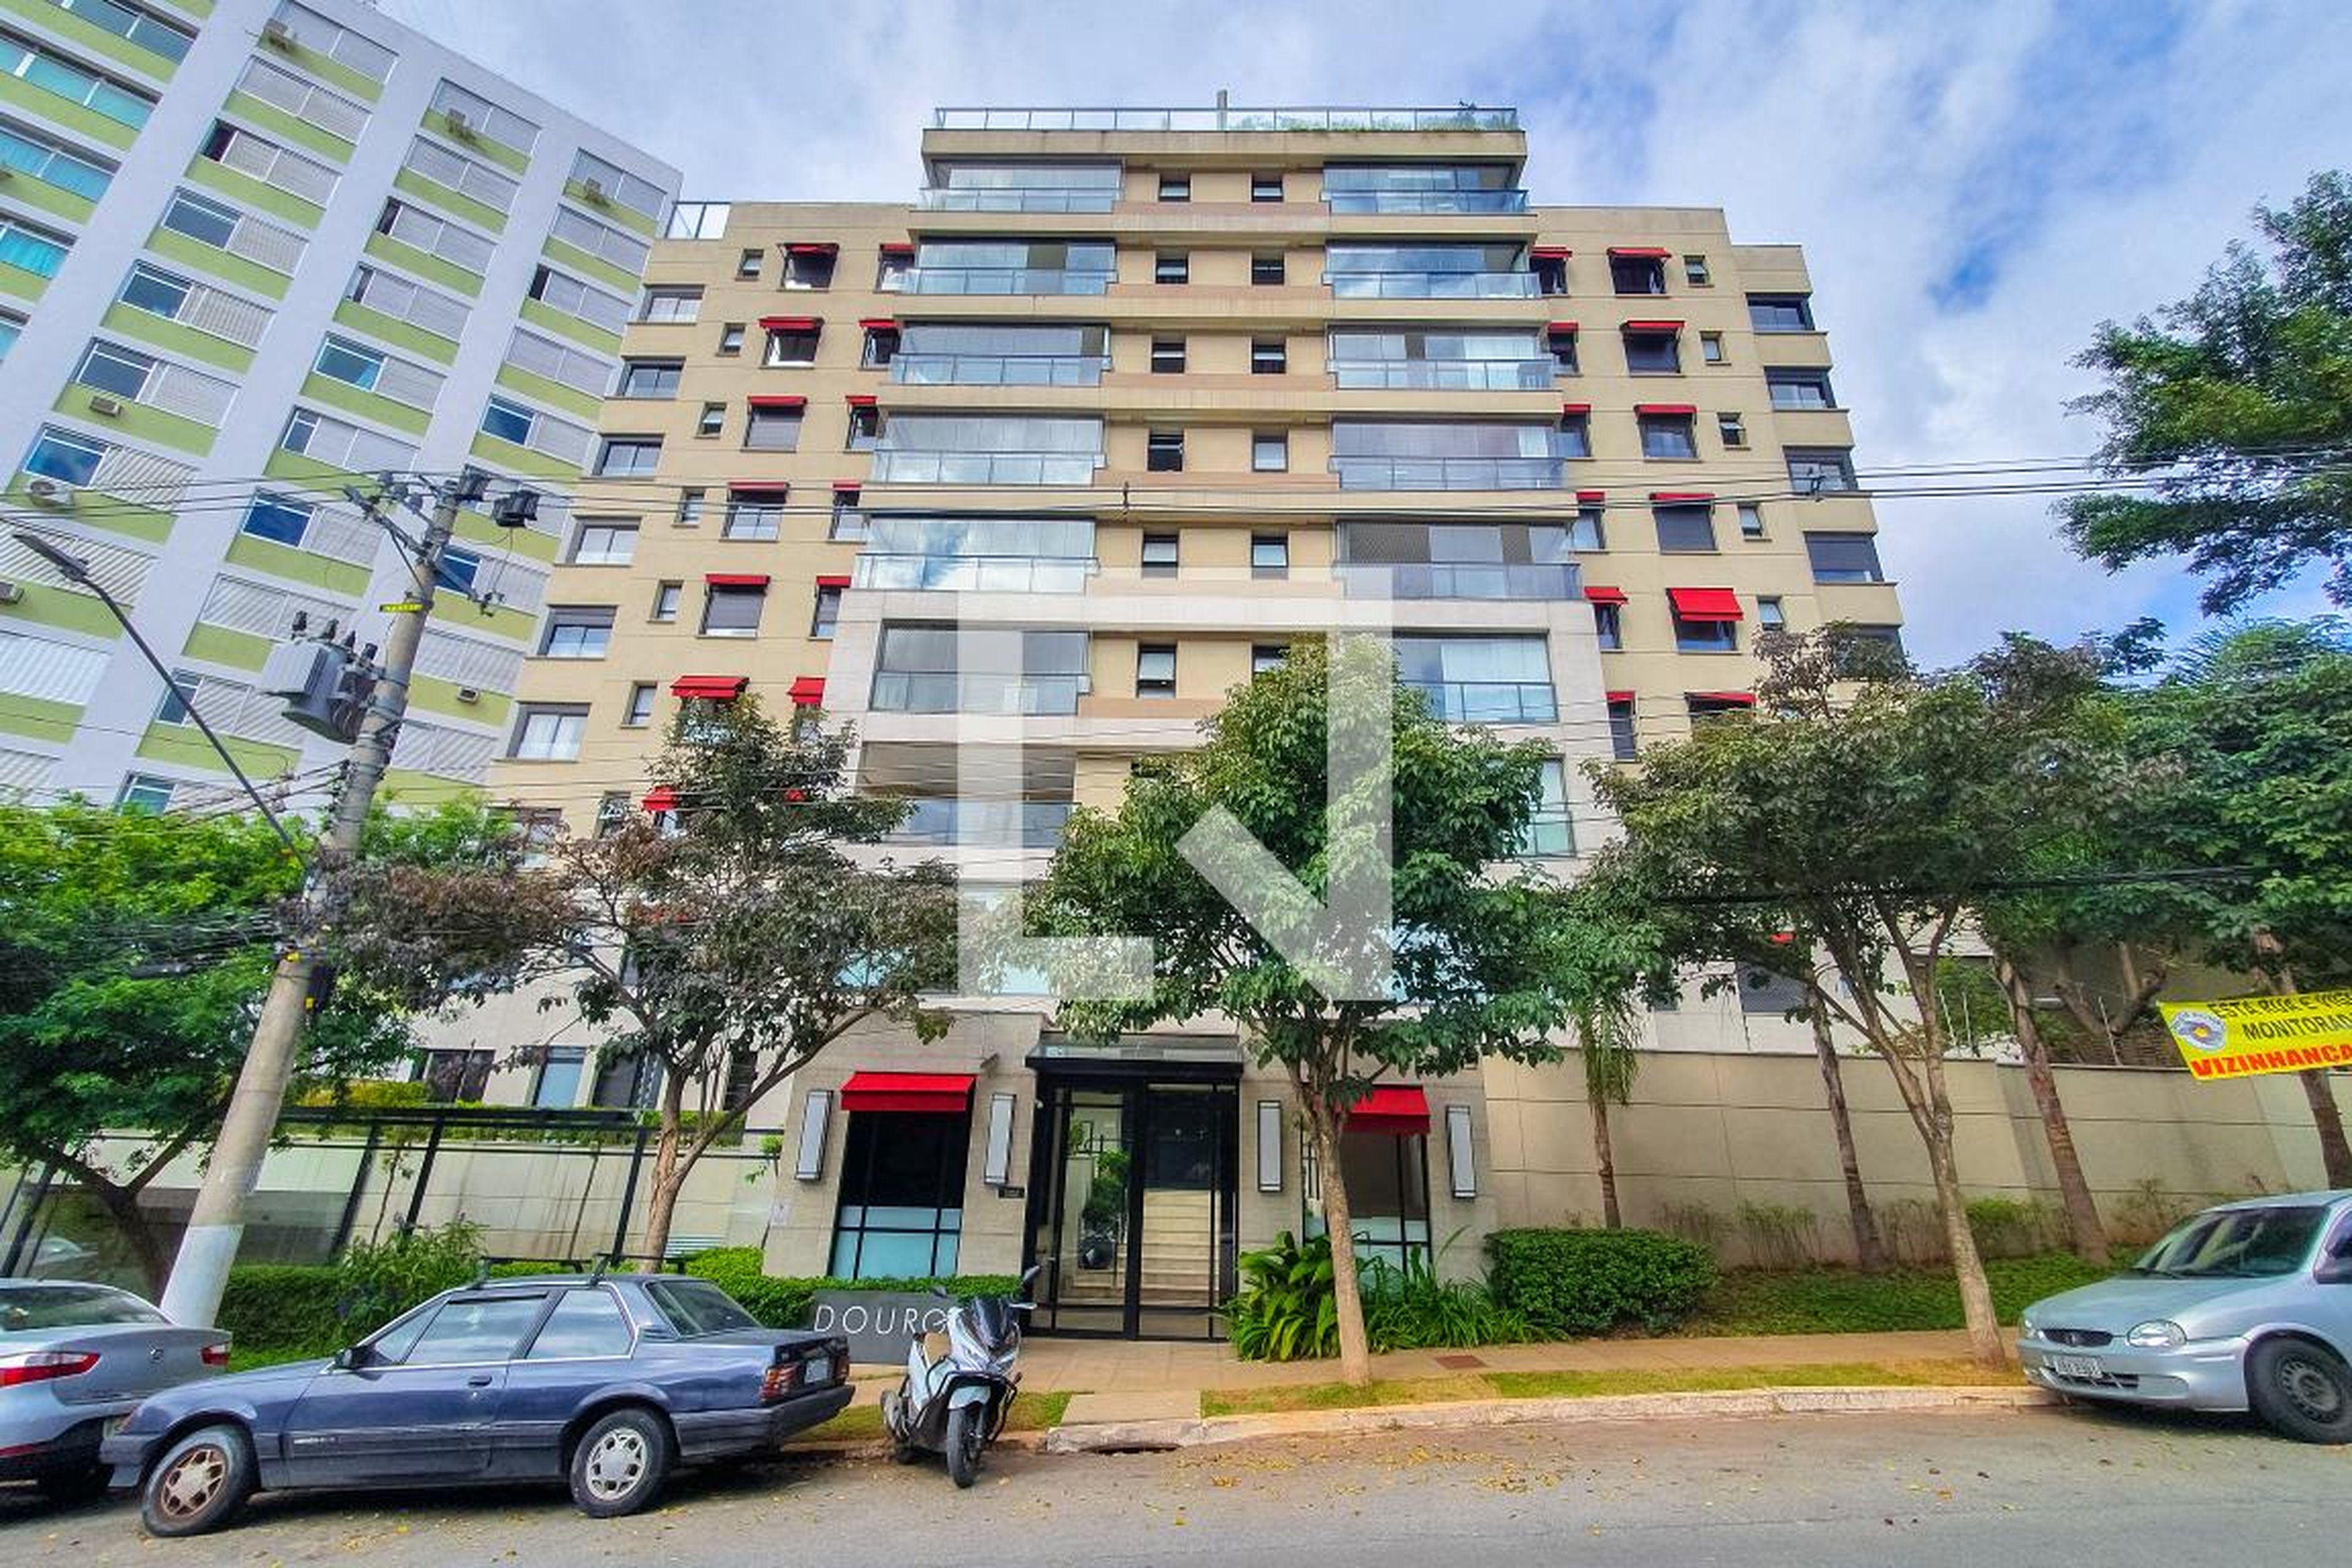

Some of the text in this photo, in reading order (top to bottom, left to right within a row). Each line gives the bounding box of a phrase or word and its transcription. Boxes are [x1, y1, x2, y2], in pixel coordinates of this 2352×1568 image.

[2207, 1001, 2255, 1018] ESTA
[2257, 998, 2301, 1014] RUA
[2242, 1012, 2352, 1041] MONITORAD
[814, 1305, 948, 1335] DOURO
